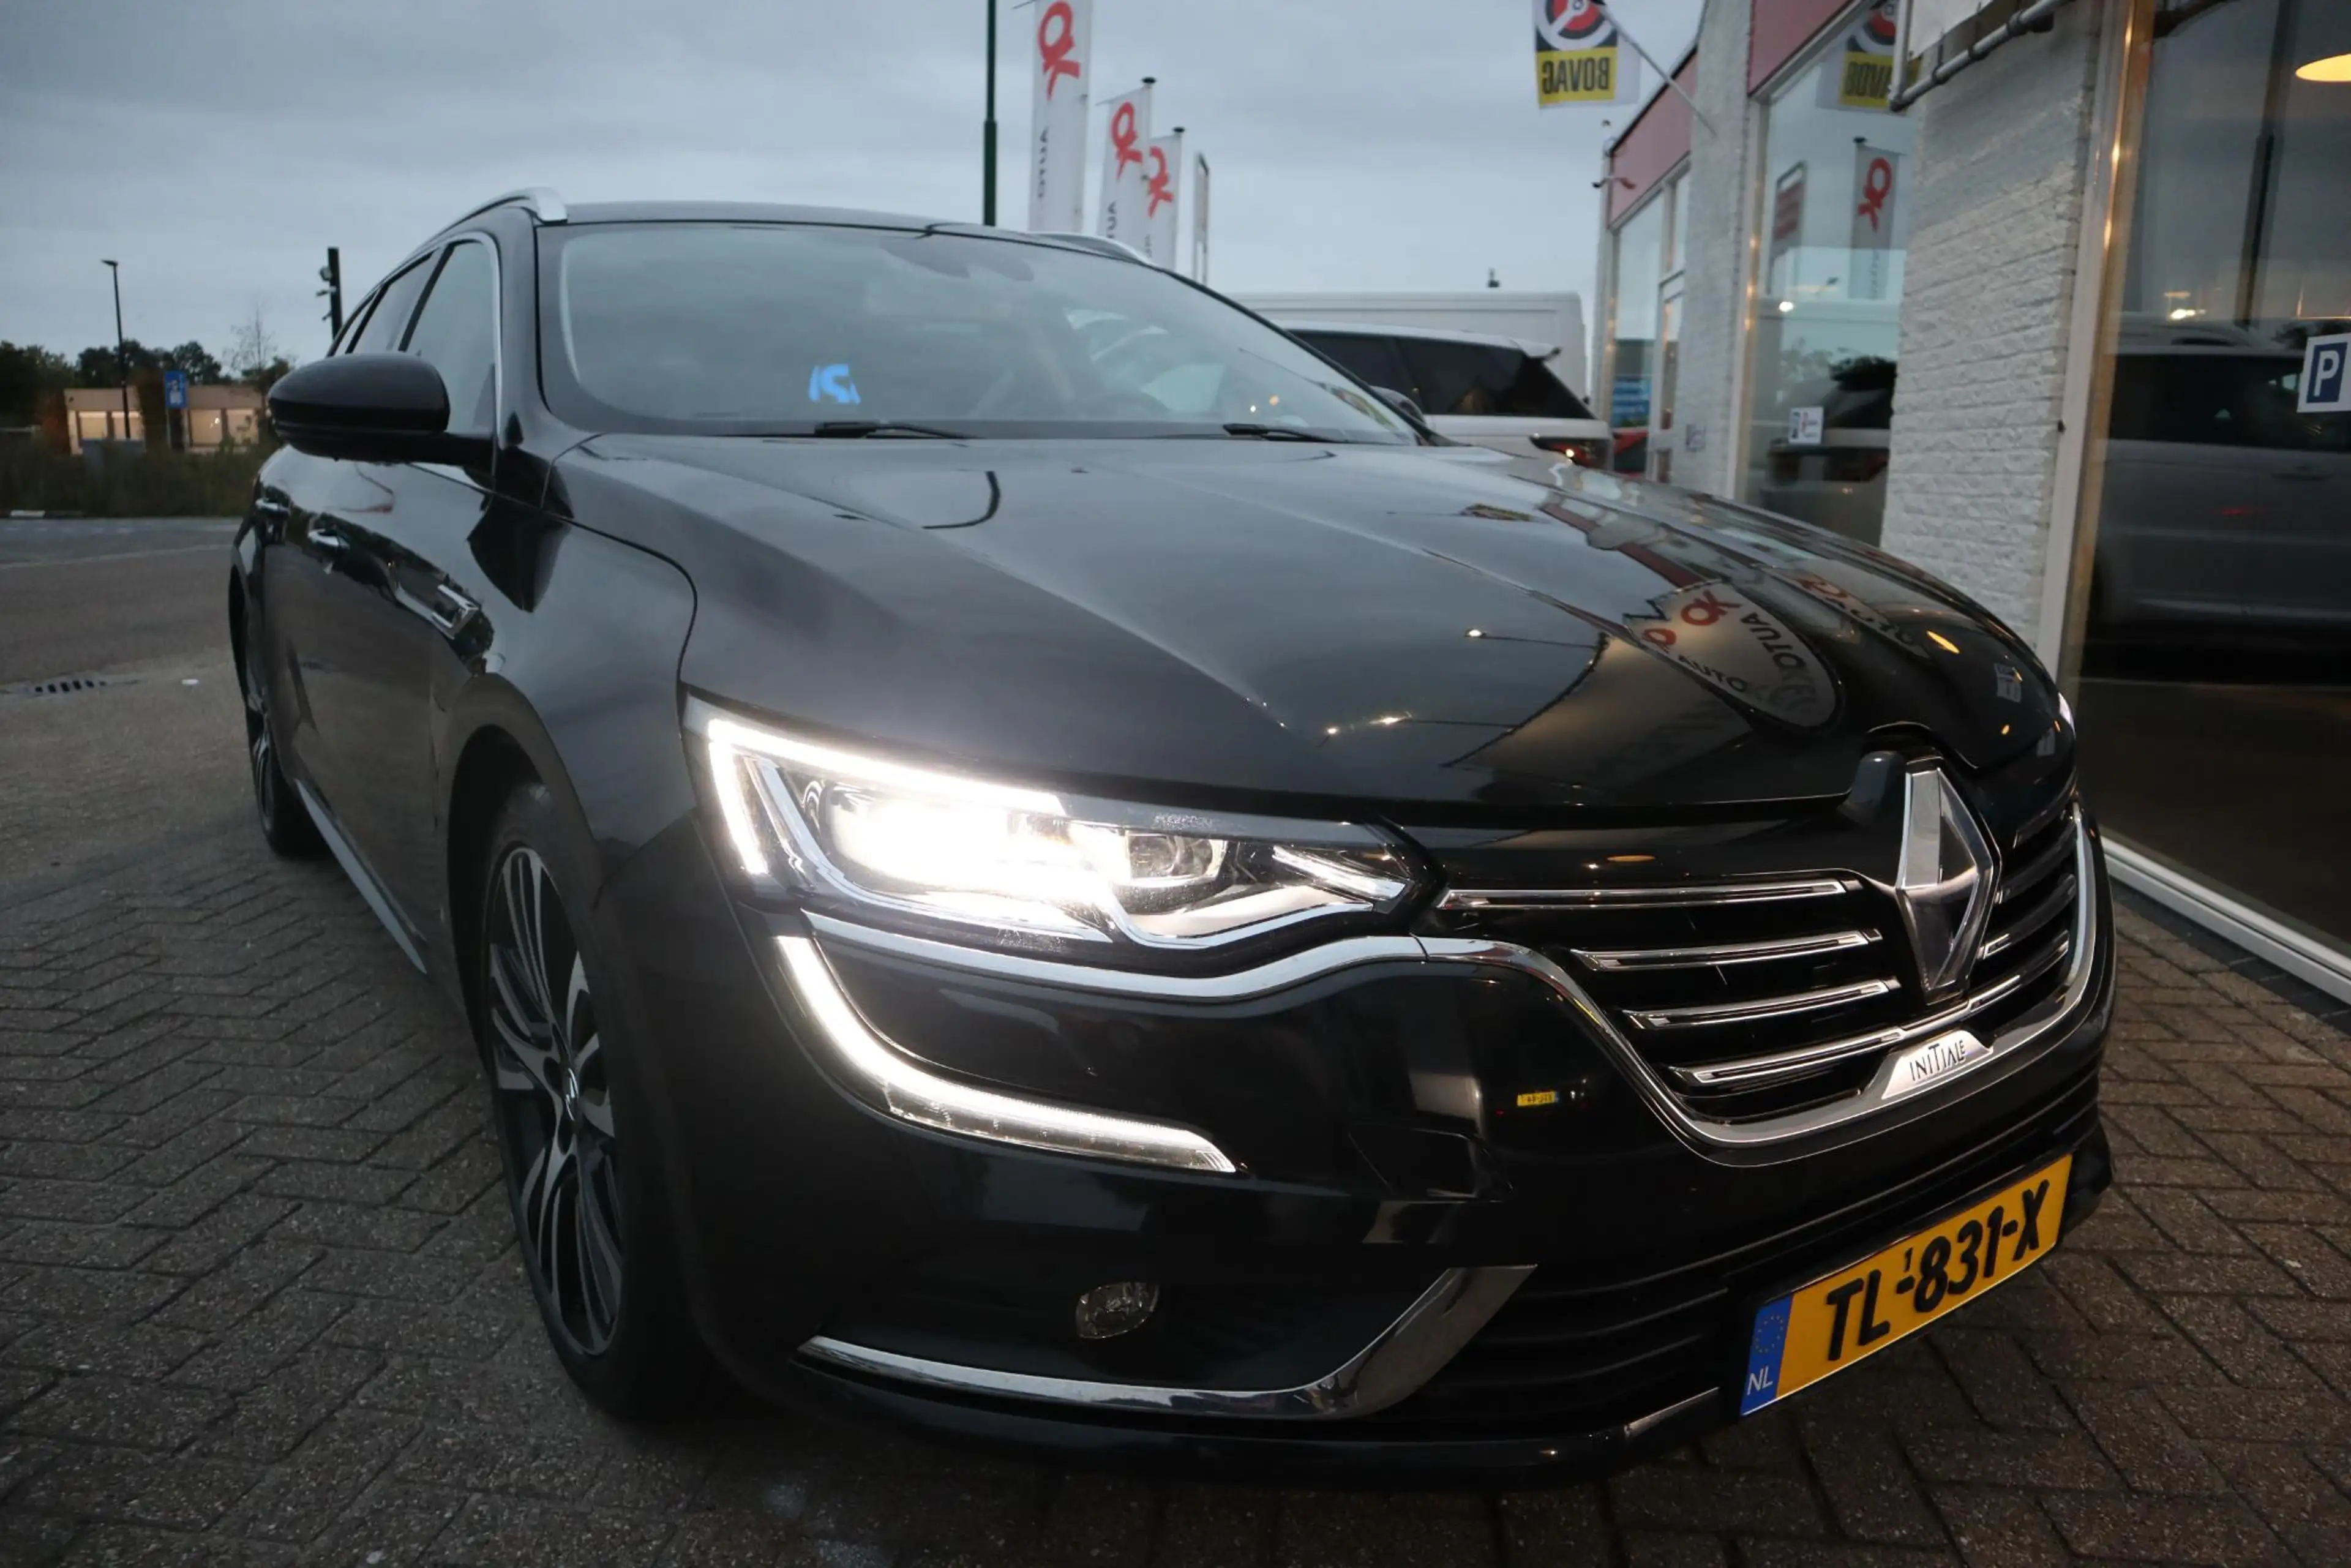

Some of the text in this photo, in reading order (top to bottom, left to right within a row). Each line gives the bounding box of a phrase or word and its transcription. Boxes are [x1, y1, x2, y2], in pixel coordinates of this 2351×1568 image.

[2314, 349, 2340, 397] P
[1909, 1040, 1967, 1082] INITIALE
[1746, 1365, 1774, 1396] NL
